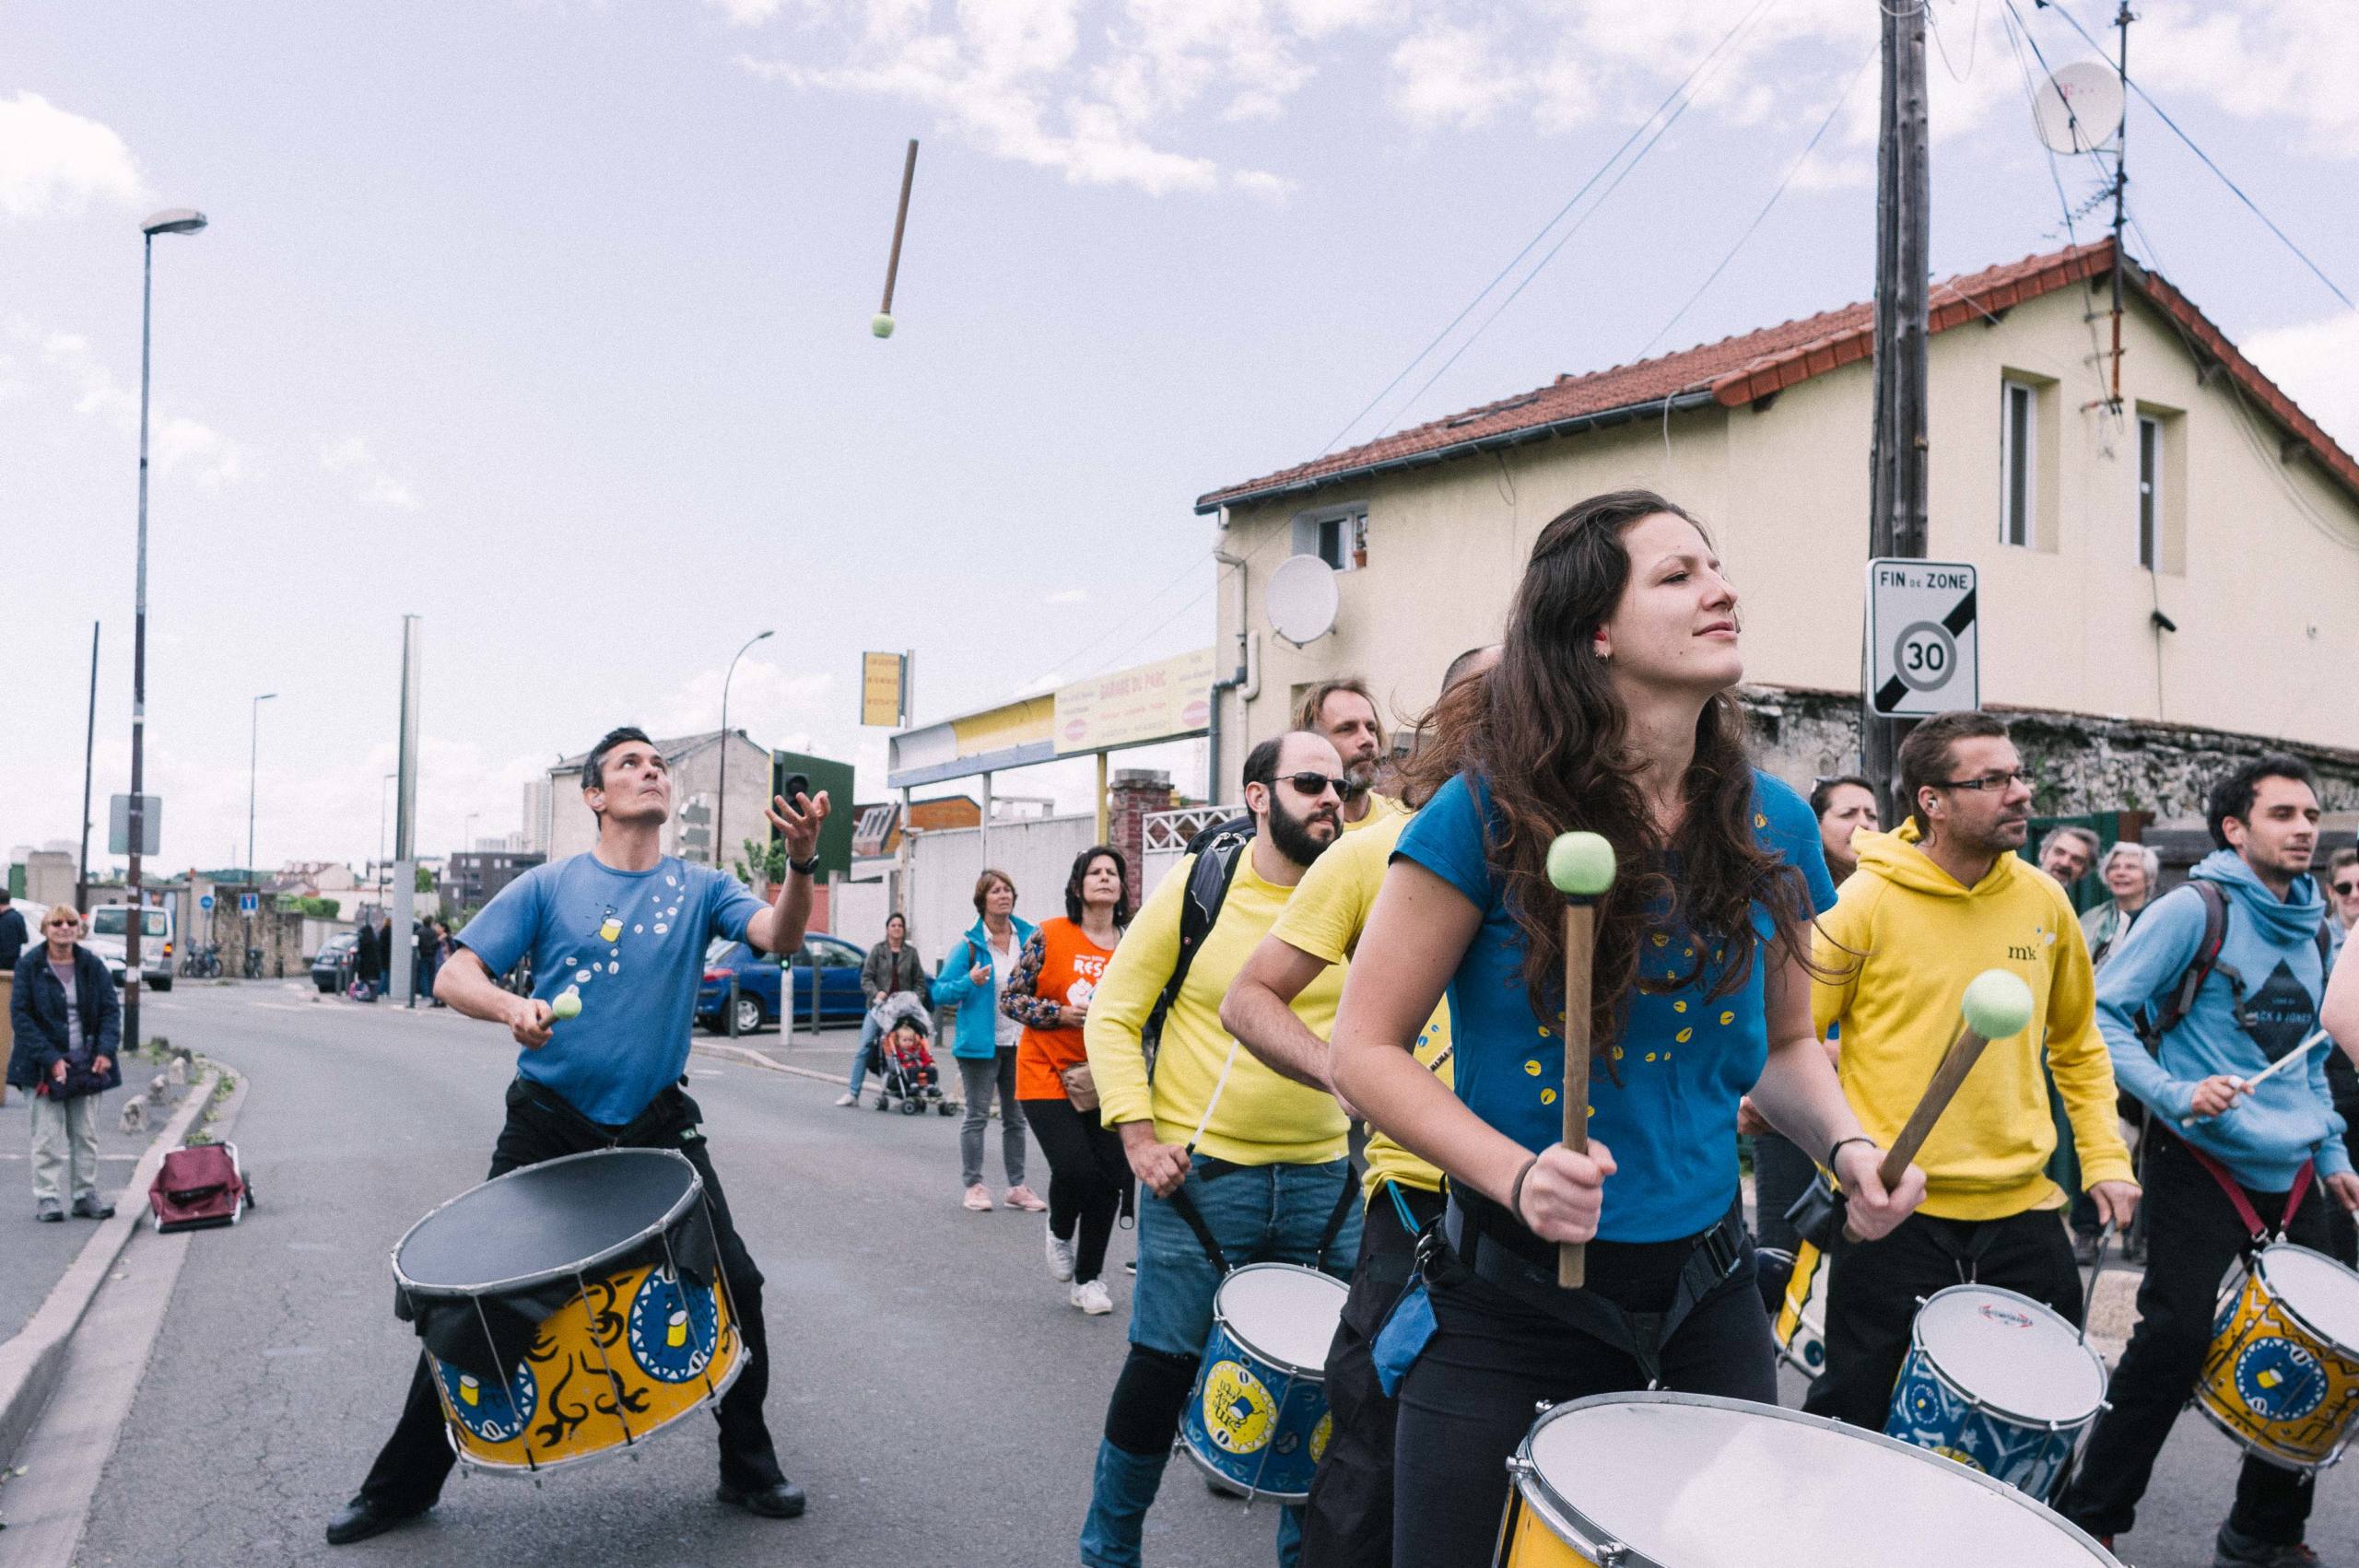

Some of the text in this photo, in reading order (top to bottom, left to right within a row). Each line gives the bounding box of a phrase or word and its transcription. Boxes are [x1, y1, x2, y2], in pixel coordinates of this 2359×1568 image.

[1880, 571, 1968, 590] FIN DE ZONE
[1907, 642, 1944, 671] 30
[1074, 959, 1109, 977] RES
